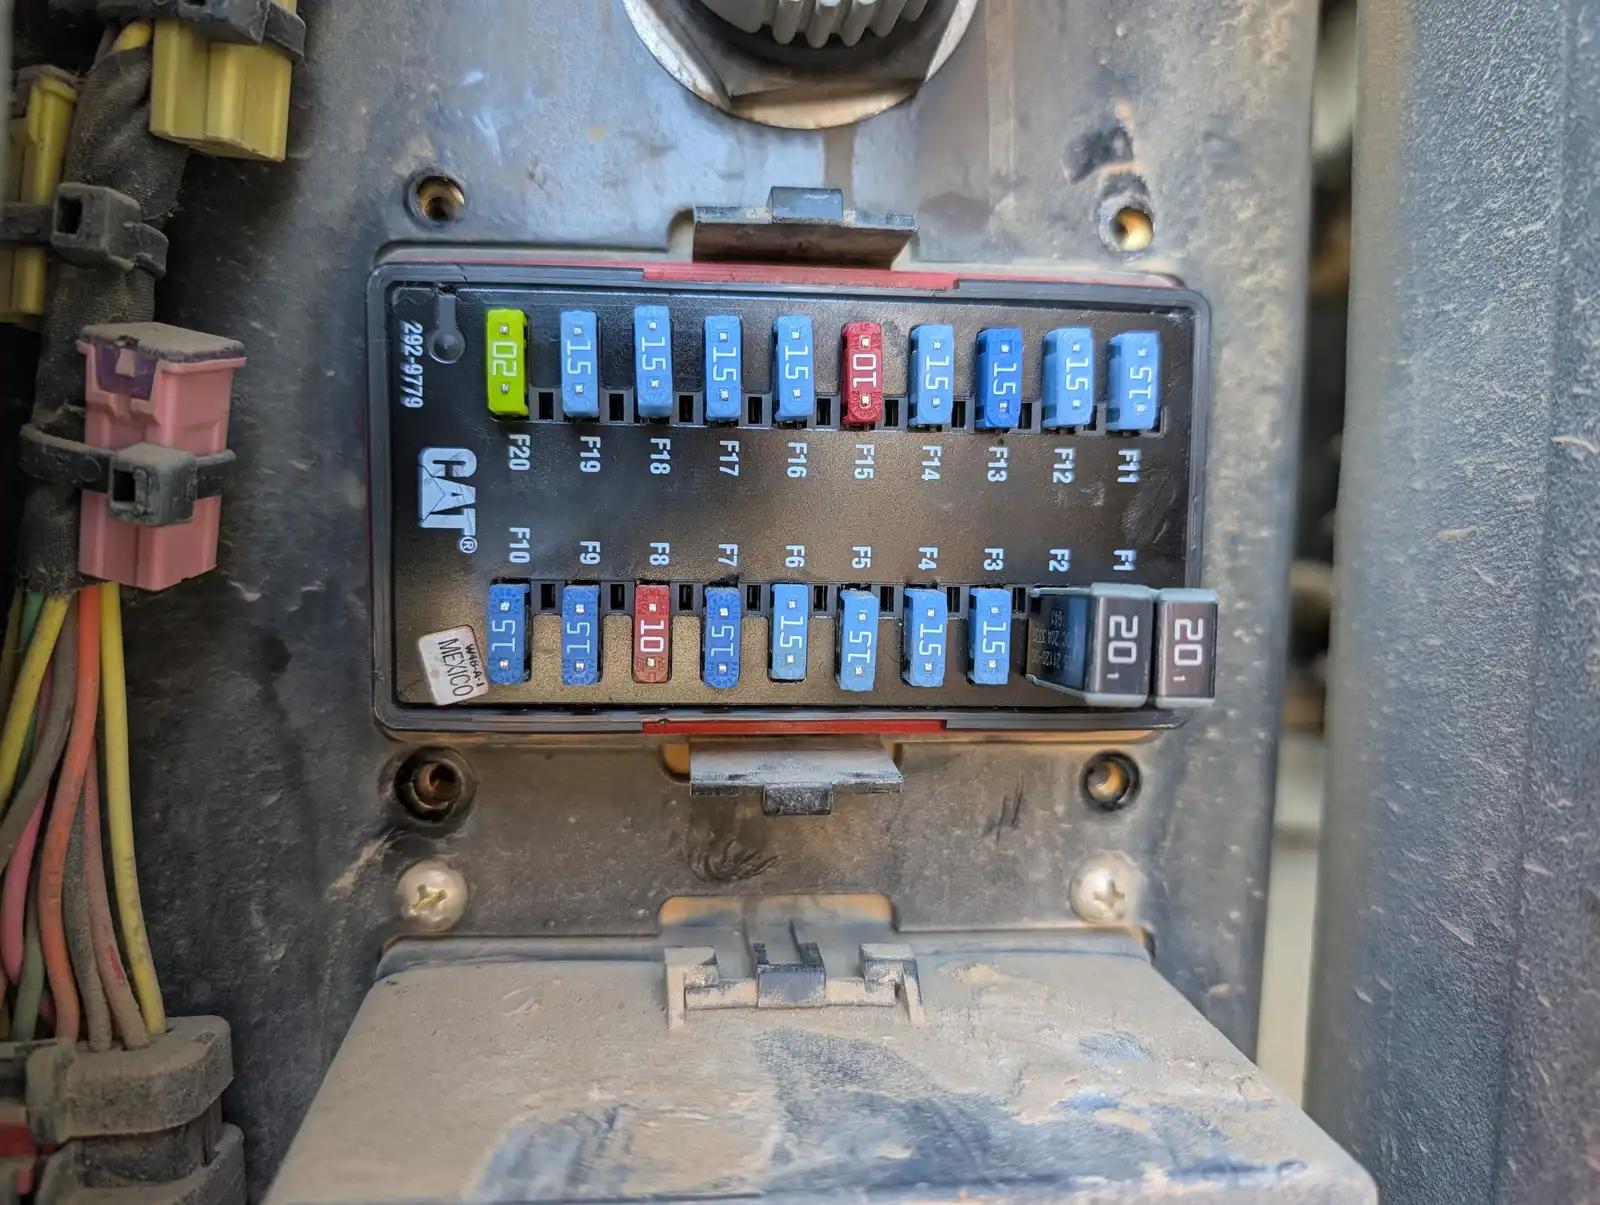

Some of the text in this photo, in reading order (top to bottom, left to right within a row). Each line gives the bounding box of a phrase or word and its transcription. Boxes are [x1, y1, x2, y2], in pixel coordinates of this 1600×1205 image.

[401, 320, 424, 408] 292-9779
[491, 340, 518, 377] 20
[566, 339, 592, 375] 15
[641, 336, 666, 371] 15
[712, 346, 737, 381] 15
[784, 345, 809, 380] 15
[852, 353, 877, 388] 10
[925, 355, 950, 390] 15
[992, 362, 1017, 395] 15
[1065, 357, 1089, 391] 15
[1128, 366, 1153, 399] 15
[508, 434, 531, 471] F20
[579, 436, 601, 473] F19
[649, 438, 671, 475] F18
[719, 440, 740, 477] F17
[786, 441, 808, 478] F16
[853, 444, 875, 480] F15
[921, 445, 942, 481] F14
[987, 446, 1008, 482] F13
[1052, 448, 1074, 484] F12
[1117, 449, 1140, 483] F11
[509, 527, 531, 564] F10
[579, 541, 601, 565] F9
[649, 542, 670, 566] F8
[717, 543, 739, 567] F7
[785, 545, 805, 568] F6
[851, 546, 872, 569] F5
[917, 546, 938, 570] F4
[983, 548, 1004, 571] F3
[1048, 548, 1070, 572] F2
[1113, 549, 1136, 571] F1
[491, 619, 516, 652] 15
[566, 622, 591, 654] 15
[640, 619, 665, 653] 10
[710, 625, 735, 657] 15
[779, 615, 804, 648] 15
[847, 631, 872, 663] 15
[918, 623, 943, 656] 15
[982, 621, 1007, 654] 15
[1108, 615, 1139, 664] 20
[1174, 618, 1204, 666] 20
[438, 638, 474, 696] MEXICO
